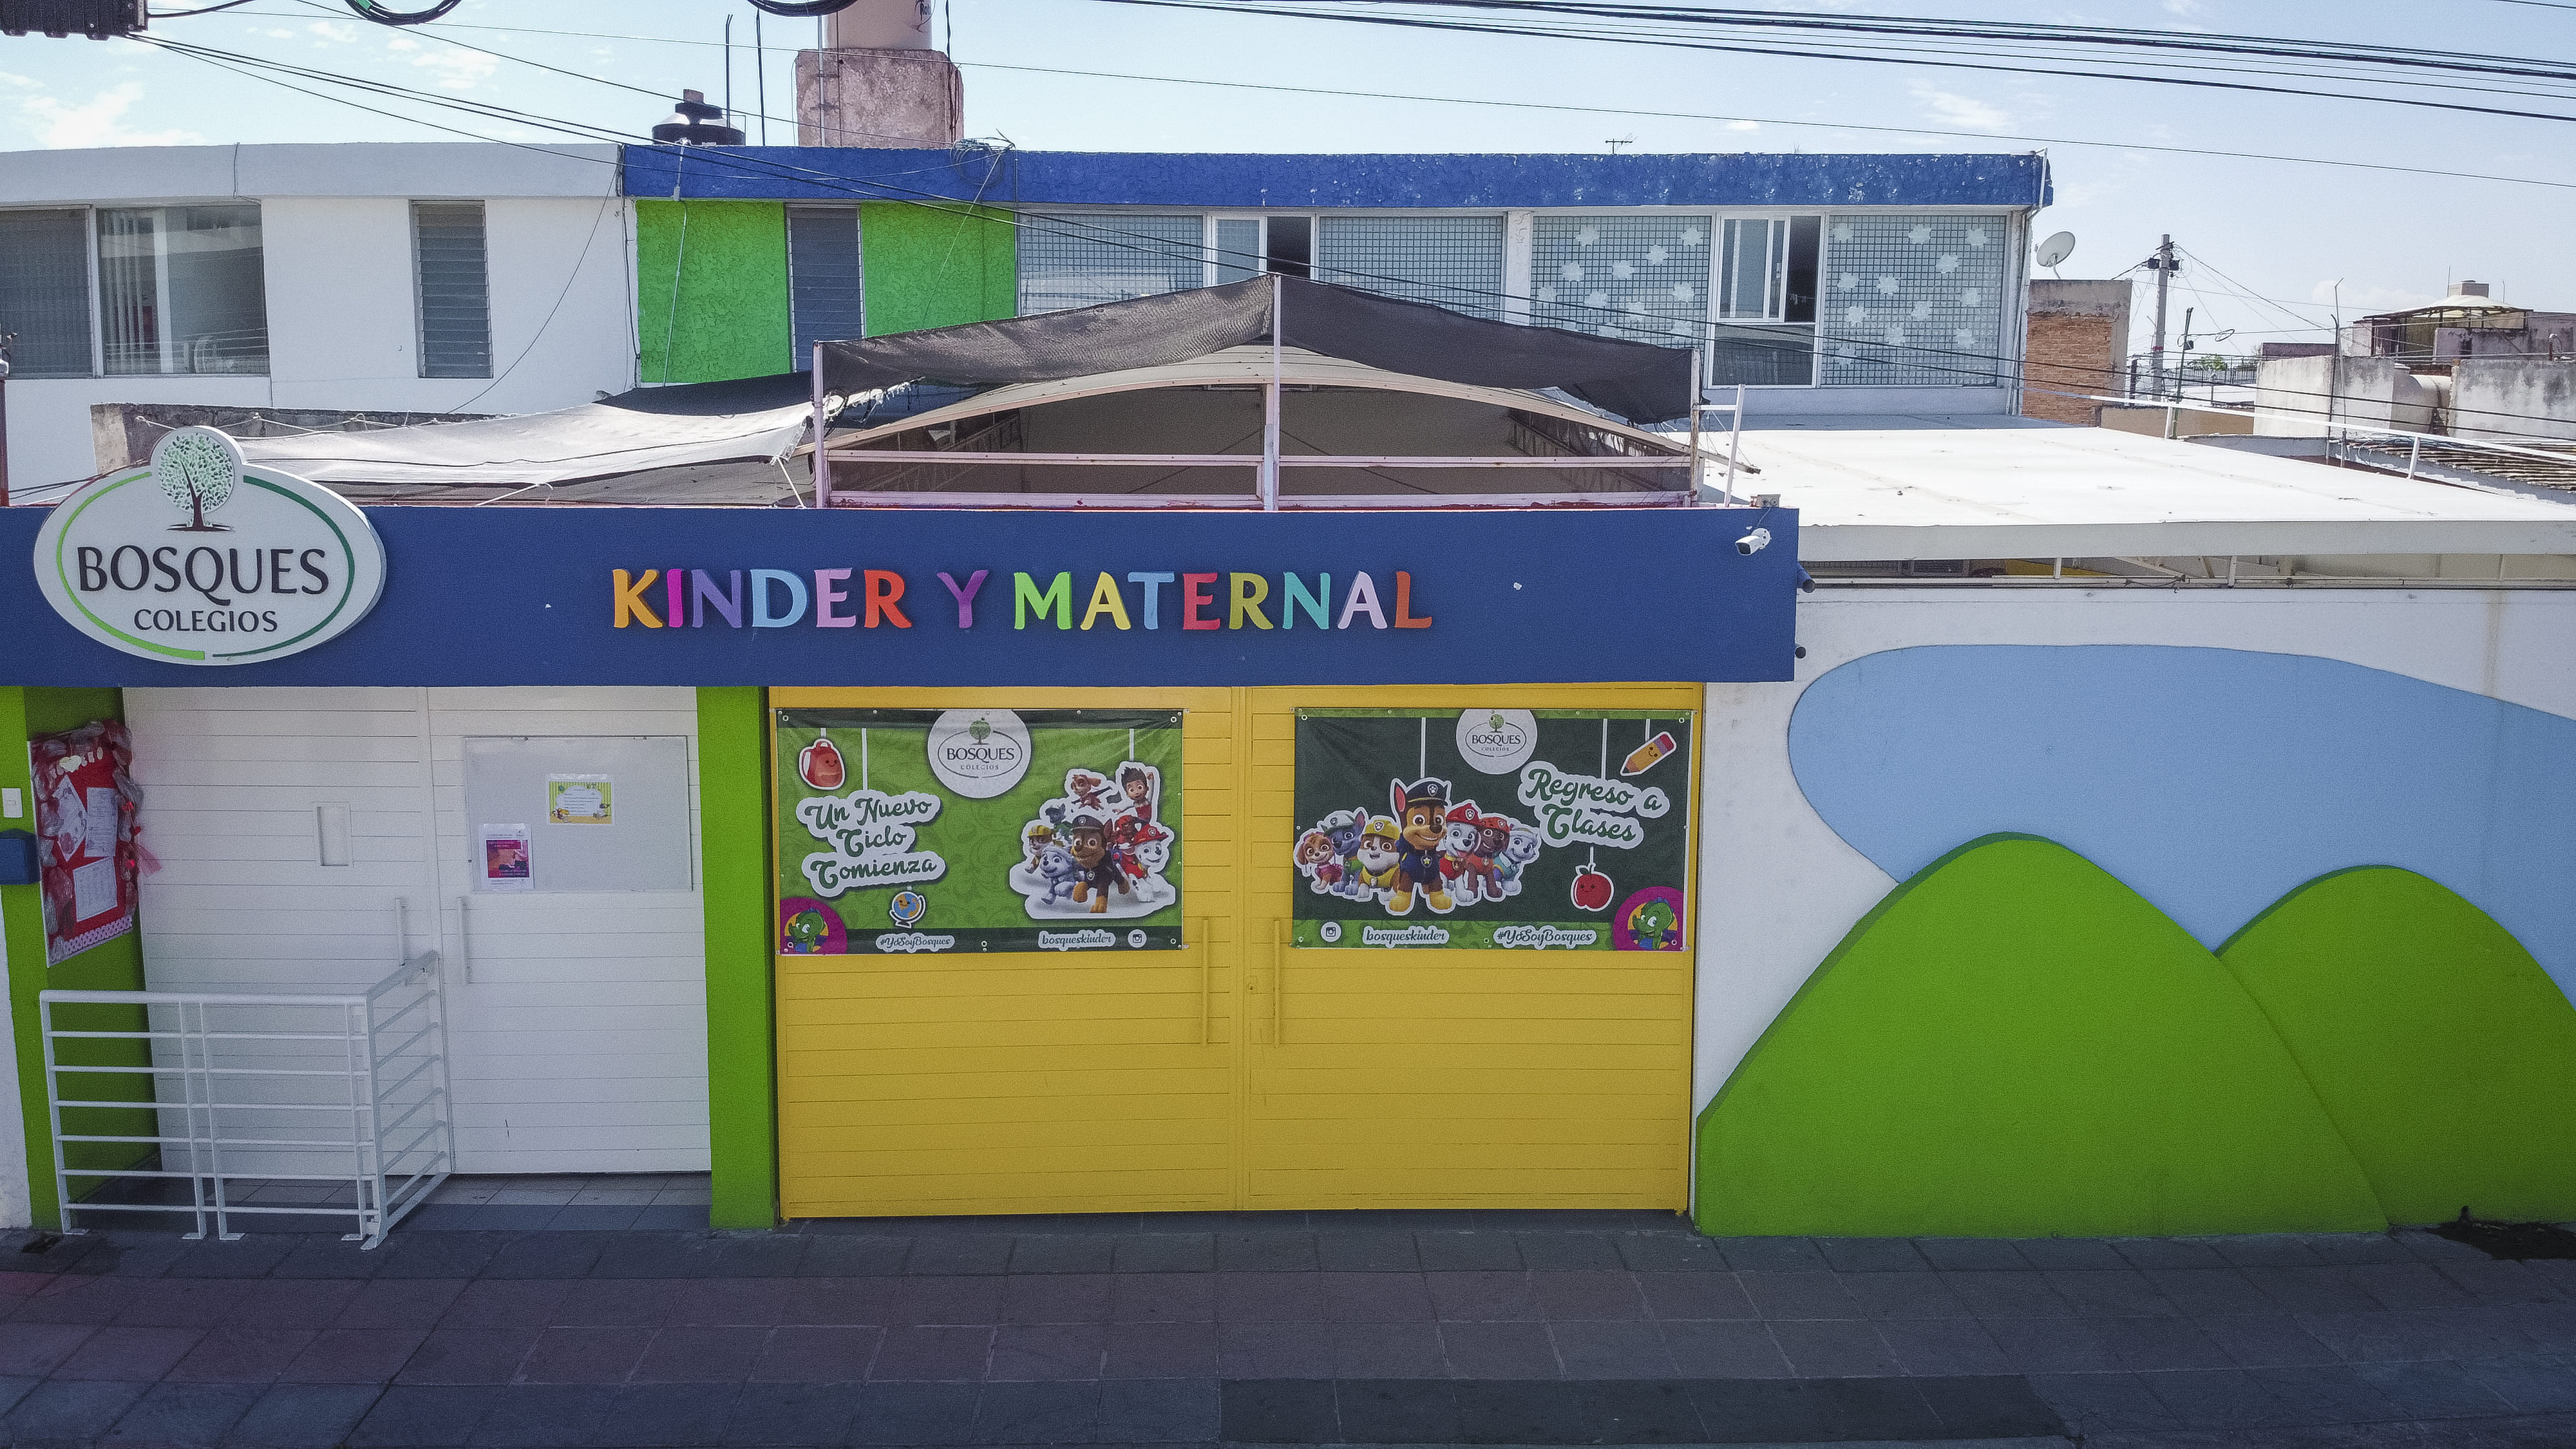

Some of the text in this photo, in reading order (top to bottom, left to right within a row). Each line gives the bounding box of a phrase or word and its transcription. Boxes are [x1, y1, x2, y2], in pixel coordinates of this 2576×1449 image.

[77, 545, 330, 606] BOSQUES
[612, 567, 1433, 630] KINDER Y MATERNAL
[133, 609, 278, 632] COLEGIOS
[1472, 734, 1521, 746] BOSQUES
[947, 748, 1015, 764] BOSQUES
[1526, 768, 1662, 811] Regreso a
[804, 797, 932, 830] Un Nuevo
[1542, 803, 1636, 842] Clases
[836, 825, 907, 857] Ciclo
[810, 858, 937, 889] Comienza
[880, 936, 951, 949] #YoSoyBosques
[1042, 933, 1112, 947] bosqueskinder
[1366, 929, 1445, 945] bosqueskinder
[1497, 929, 1593, 947] #YoSoyBosques
